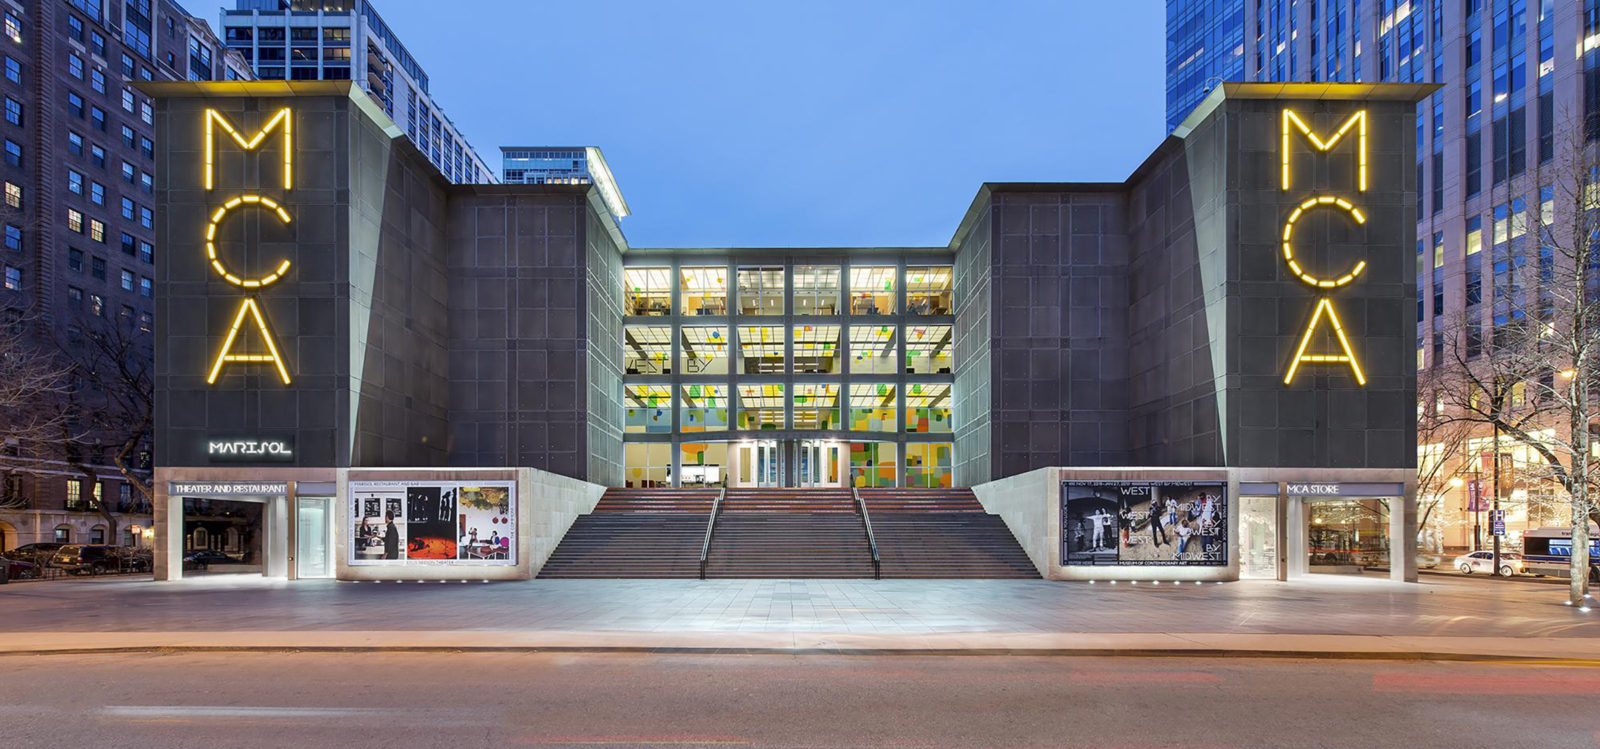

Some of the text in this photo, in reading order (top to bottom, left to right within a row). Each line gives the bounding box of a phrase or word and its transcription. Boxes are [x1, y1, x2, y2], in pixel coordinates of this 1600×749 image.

[205, 107, 292, 386] MCA
[1281, 107, 1367, 387] MCA
[209, 441, 292, 455] MARISOL
[176, 484, 287, 494] THEATER AND RESTAURANT
[1120, 486, 1150, 496] WEST
[1286, 484, 1340, 494] MCA STORE
[1205, 494, 1221, 503] BY
[1120, 511, 1150, 520] WEST
[1495, 511, 1504, 520] H
[1205, 543, 1221, 552] BY
[1172, 551, 1221, 561] MIDWEST
